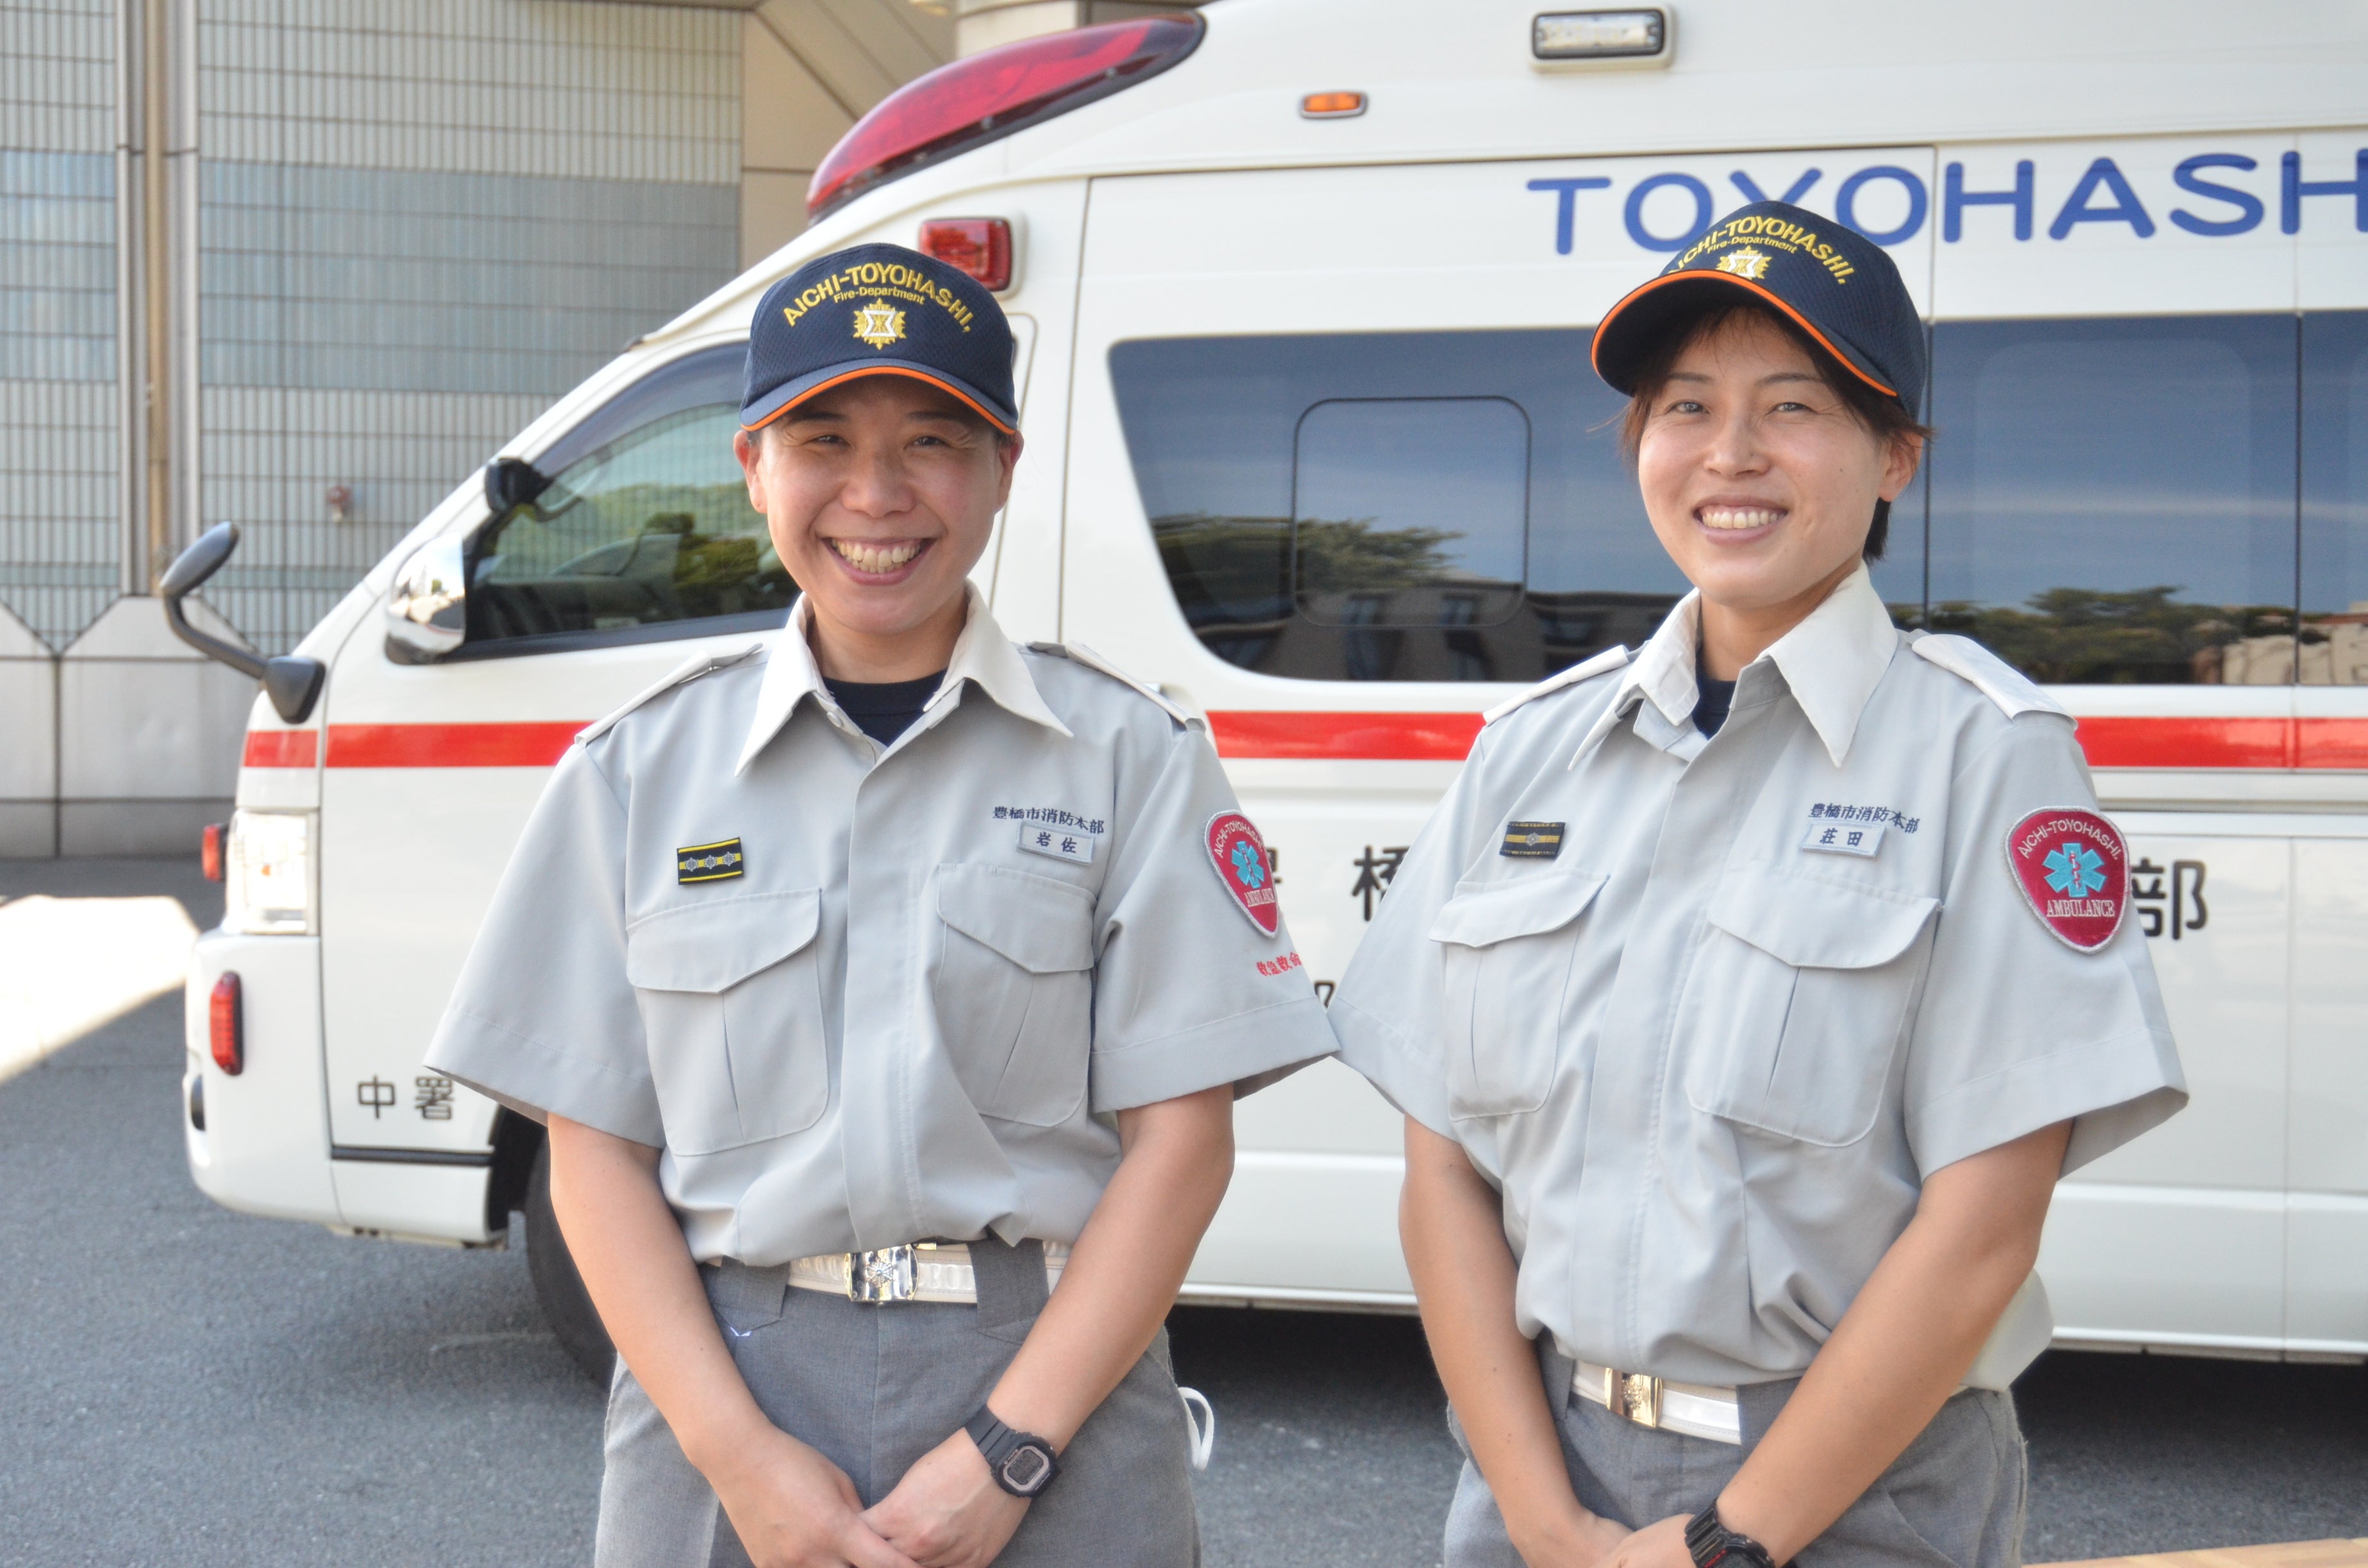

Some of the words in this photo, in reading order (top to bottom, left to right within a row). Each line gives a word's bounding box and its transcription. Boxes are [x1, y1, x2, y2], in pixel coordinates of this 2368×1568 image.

[1668, 216, 1855, 284] ICHI-TOYOHASHI.
[1707, 236, 1797, 254] Fire-Department
[834, 286, 925, 304] Fire-Department
[992, 806, 1105, 835] 豊橋市消防本部
[1808, 803, 1920, 834] 豊橋市消防本部
[2046, 899, 2115, 918] AMBULANCE
[358, 1075, 455, 1120] 中署
